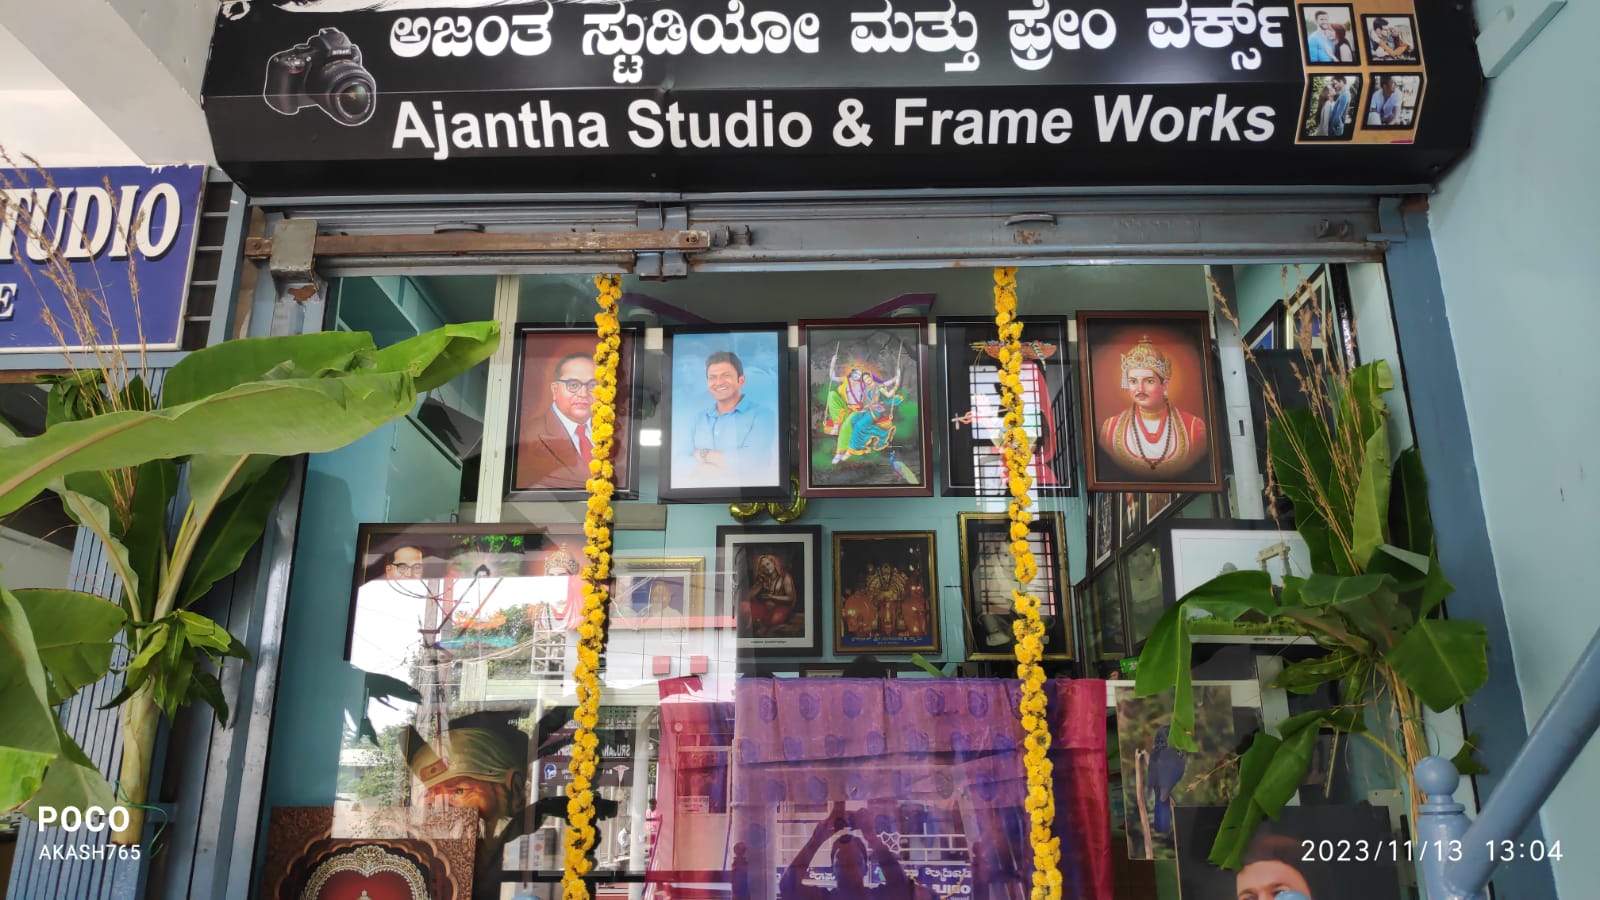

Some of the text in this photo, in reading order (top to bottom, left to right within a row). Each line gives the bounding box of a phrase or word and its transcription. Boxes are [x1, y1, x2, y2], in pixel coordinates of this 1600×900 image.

[389, 0, 554, 58] ಅಜಂತ
[582, 0, 820, 84] ಸ್ಟುಡಿಯೋ
[850, 0, 980, 73] ಮತ್ತು
[392, 93, 1276, 161] Ajantha Studio & Frame Works
